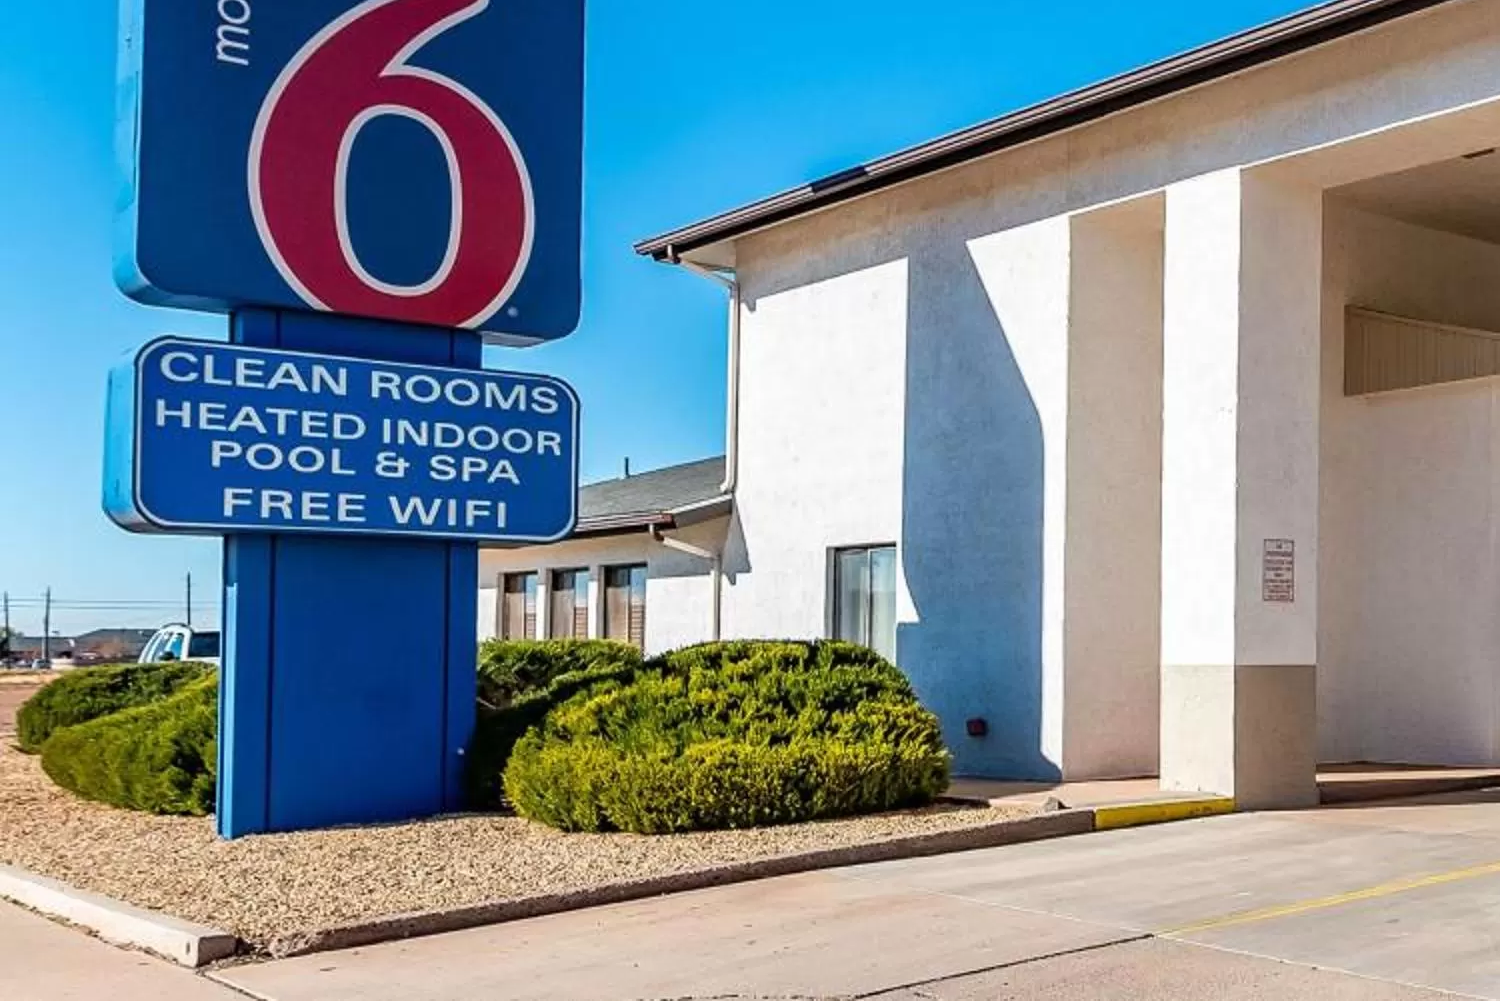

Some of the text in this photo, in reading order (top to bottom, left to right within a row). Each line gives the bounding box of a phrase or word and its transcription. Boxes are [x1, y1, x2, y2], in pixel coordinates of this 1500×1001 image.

[159, 351, 560, 415] CLEAN ROOMS
[154, 399, 562, 456] HEATED INDOOR
[210, 439, 521, 485] POOL & SPA
[222, 487, 507, 529] FREE WIFI
